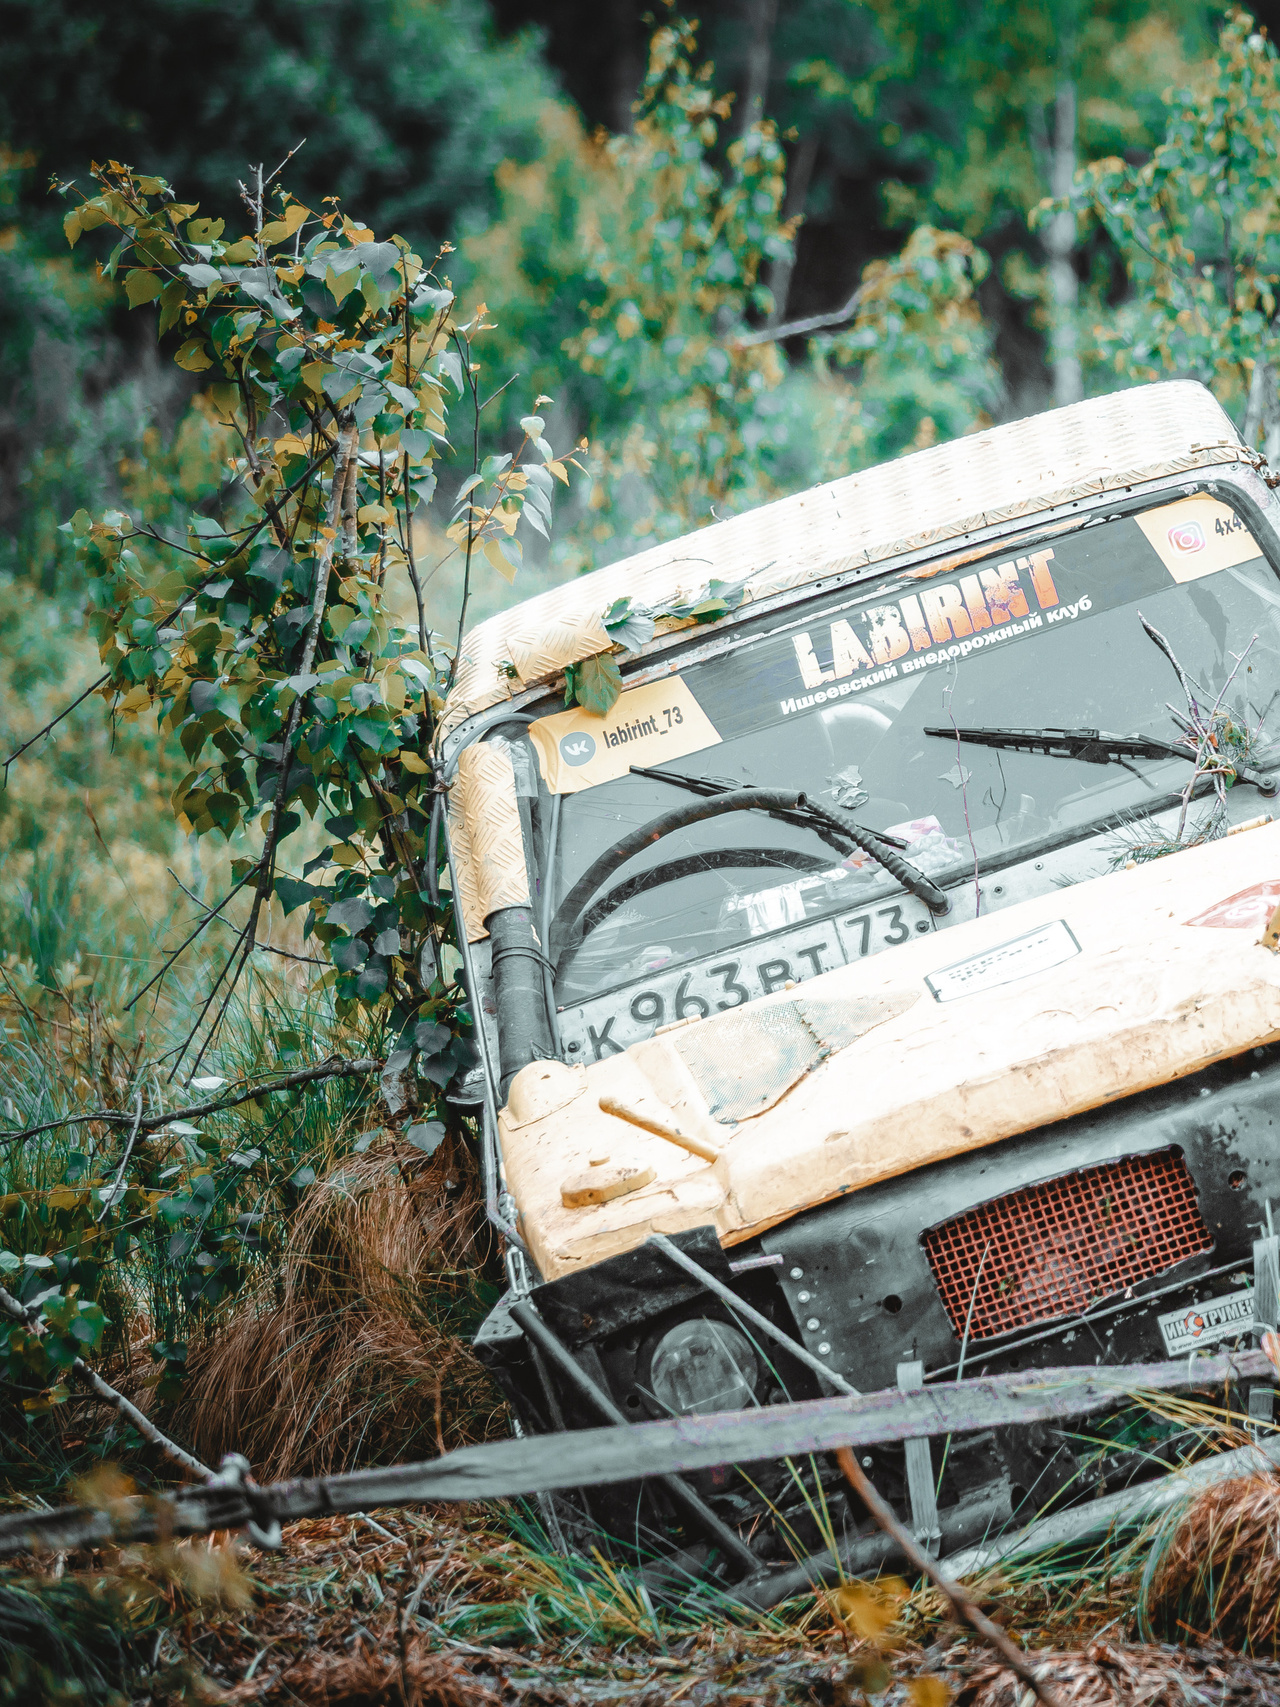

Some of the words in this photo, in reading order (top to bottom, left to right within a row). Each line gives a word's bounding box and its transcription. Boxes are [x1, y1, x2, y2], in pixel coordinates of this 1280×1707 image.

[780, 663, 899, 715] Ишеевский
[901, 609, 1044, 674] внедорожный
[1046, 595, 1093, 624] клуб
[792, 548, 1059, 689] LABIRINT
[603, 706, 684, 748] labirint_73
[846, 905, 909, 956] 73
